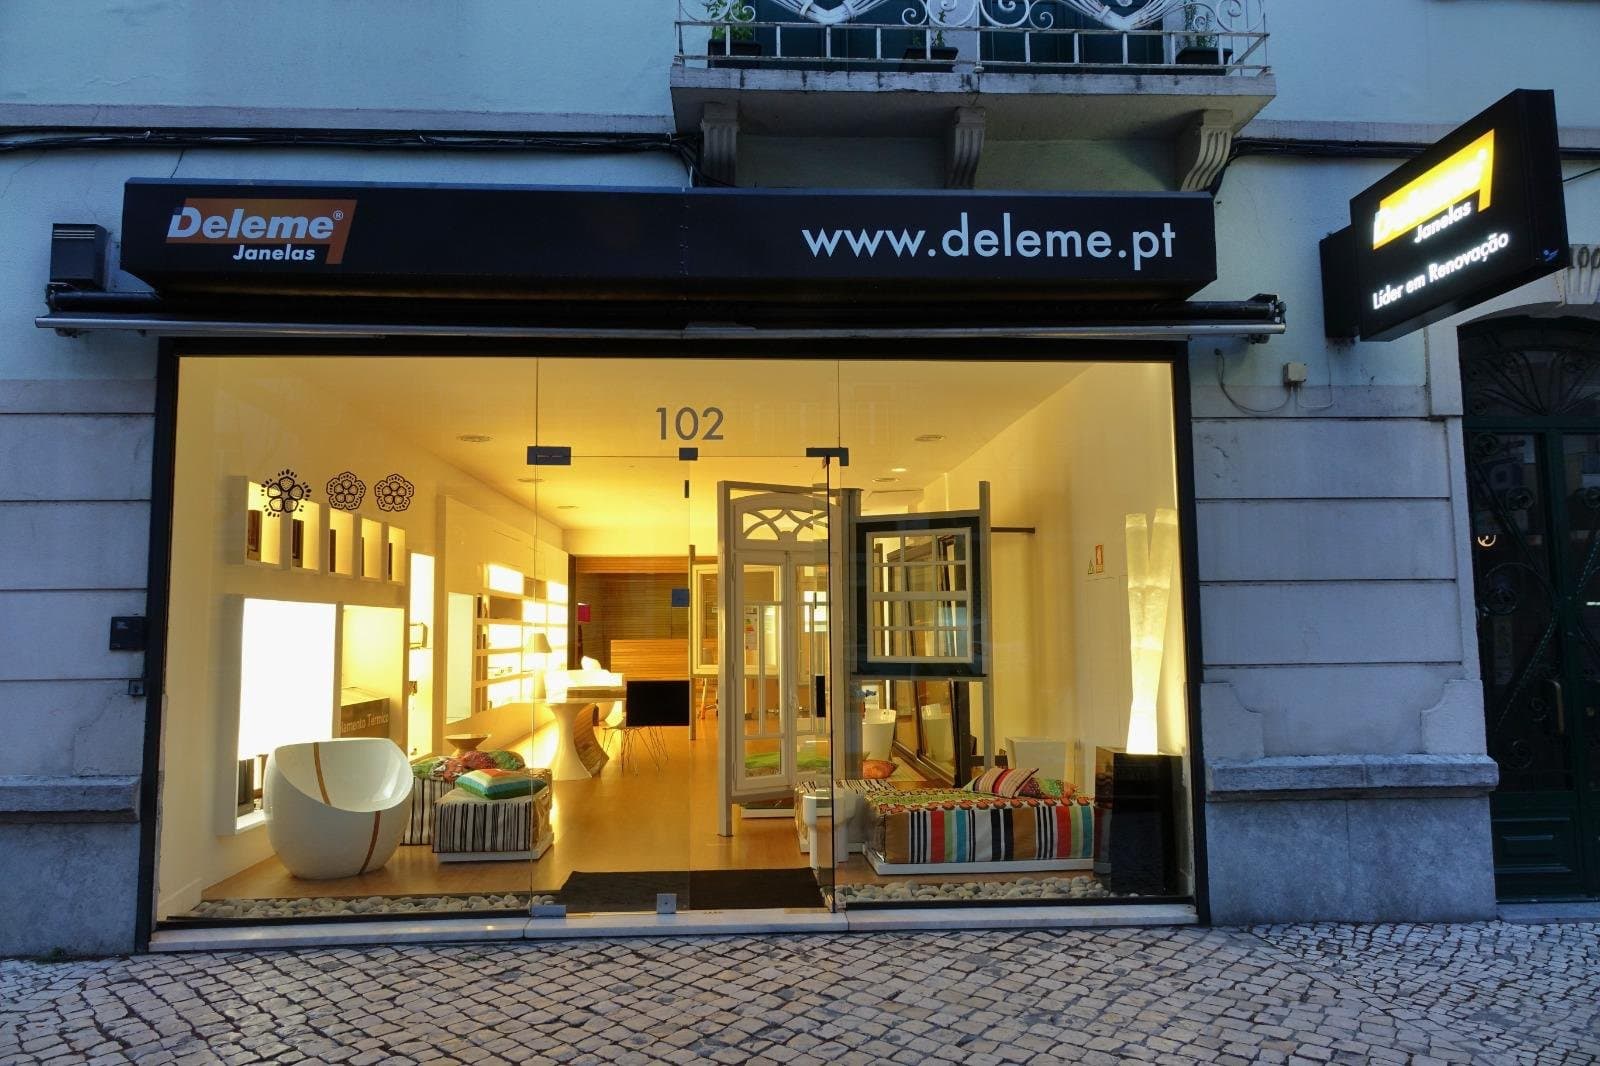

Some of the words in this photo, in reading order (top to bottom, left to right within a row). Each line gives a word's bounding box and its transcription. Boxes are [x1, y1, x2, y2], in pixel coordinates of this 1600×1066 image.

[801, 211, 1176, 271] www.deleme.pt
[1413, 201, 1472, 243] Janelas
[232, 243, 316, 261] Janelas
[1373, 284, 1404, 310] Líder
[1405, 274, 1426, 294] em
[1428, 232, 1510, 283] Renovação
[655, 406, 724, 441] 102
